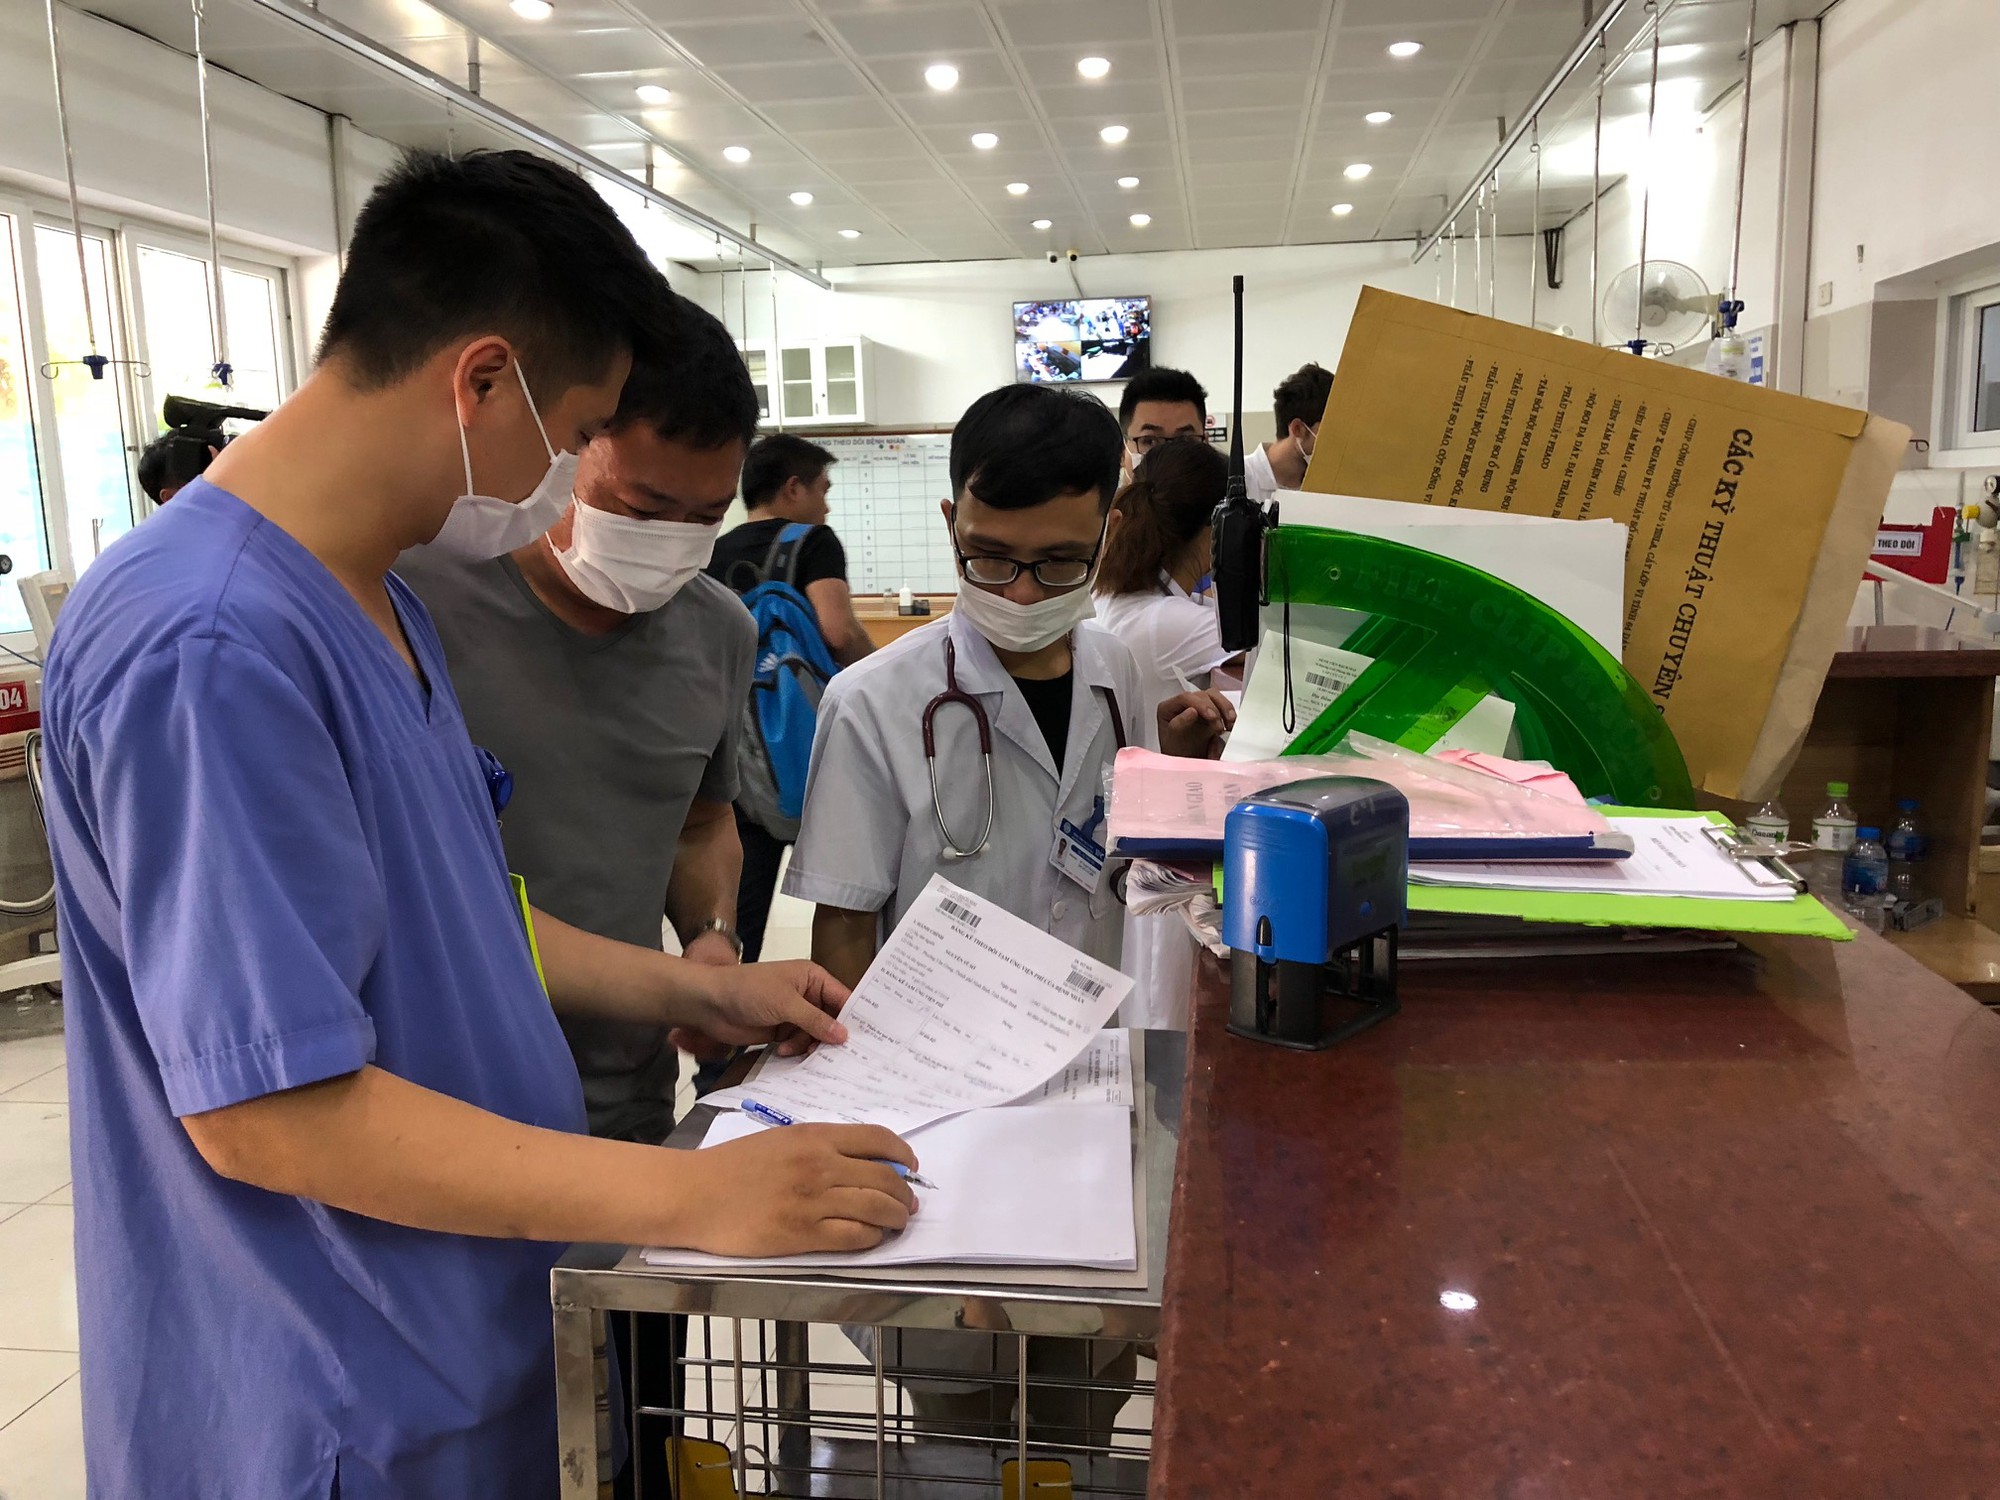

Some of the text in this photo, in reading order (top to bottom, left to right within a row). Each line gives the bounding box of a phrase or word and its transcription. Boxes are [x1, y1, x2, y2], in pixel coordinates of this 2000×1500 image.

[1451, 384, 1467, 414] THUẬT
[1475, 391, 1492, 421] THUẬT
[1585, 392, 1597, 410] NỘI
[1500, 397, 1517, 427] THUẬT
[1525, 413, 1538, 431] NỘI
[1580, 409, 1592, 425] SOI
[1470, 419, 1483, 438] NỘI
[1549, 410, 1566, 441] THUẬT
[1575, 425, 1588, 438] DẠ
[1658, 411, 1672, 436] CHỤP
[1683, 418, 1698, 443] CHỤP
[865, 437, 884, 445] BỆNH
[1465, 437, 1477, 454] SOI
[1494, 426, 1508, 444] NỘI
[1520, 430, 1533, 447] SOI
[1655, 436, 1665, 444] X
[1489, 444, 1502, 460] SOI
[1540, 439, 1556, 470] PHACO
[1645, 444, 1662, 476] QUANG
[1722, 428, 1754, 476] CÁC
[1479, 468, 1494, 494] BỤNG
[1505, 477, 1518, 495] NỘI
[1500, 494, 1512, 511] SOI
[1632, 491, 1648, 520] THUẬT
[1710, 477, 1739, 516] KỸ
[1877, 538, 1899, 549] THEO
[1684, 520, 1725, 600] THUẬT
[1634, 589, 1645, 599] VI
[1651, 603, 1698, 700] CHUYÊN
[0, 687, 23, 711] 04
